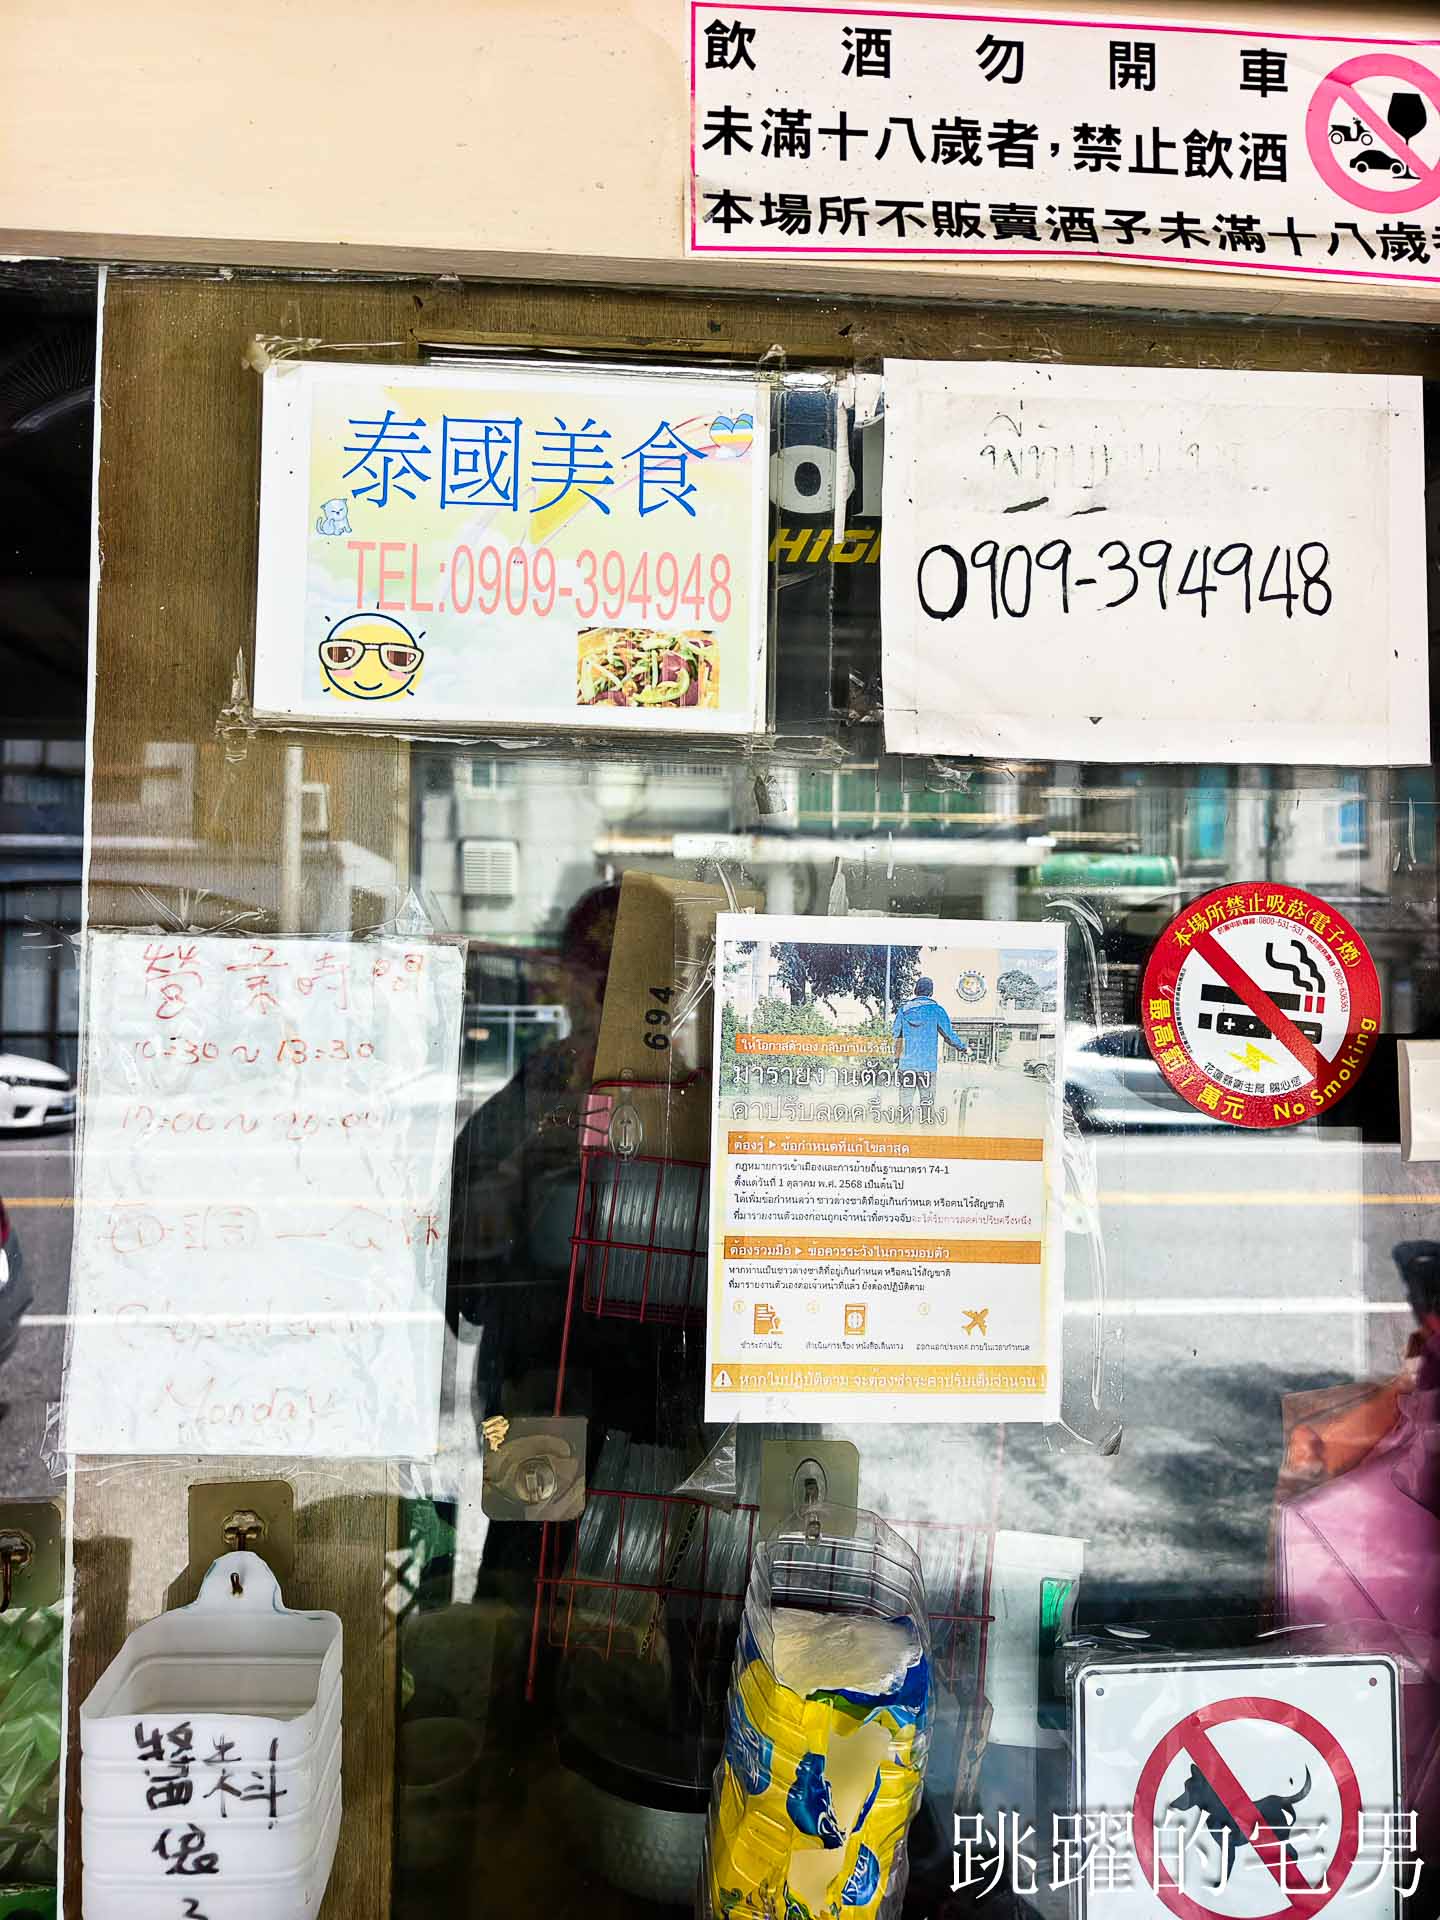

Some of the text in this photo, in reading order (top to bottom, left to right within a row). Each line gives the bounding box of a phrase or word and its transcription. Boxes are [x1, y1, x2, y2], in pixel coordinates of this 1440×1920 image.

[704, 19, 1288, 98] 飲酒勿開車
[702, 187, 1440, 264] 本場所不販賣酒予未滿十八歲
[341, 408, 709, 518] 泰國美食
[347, 540, 732, 623] TEL:0909-394948
[917, 539, 1333, 621] 0909-394948
[643, 986, 675, 1051] 694
[1272, 1017, 1377, 1121] No Smoking
[839, 1178, 863, 1189] 2568
[928, 1164, 950, 1175] 74-1
